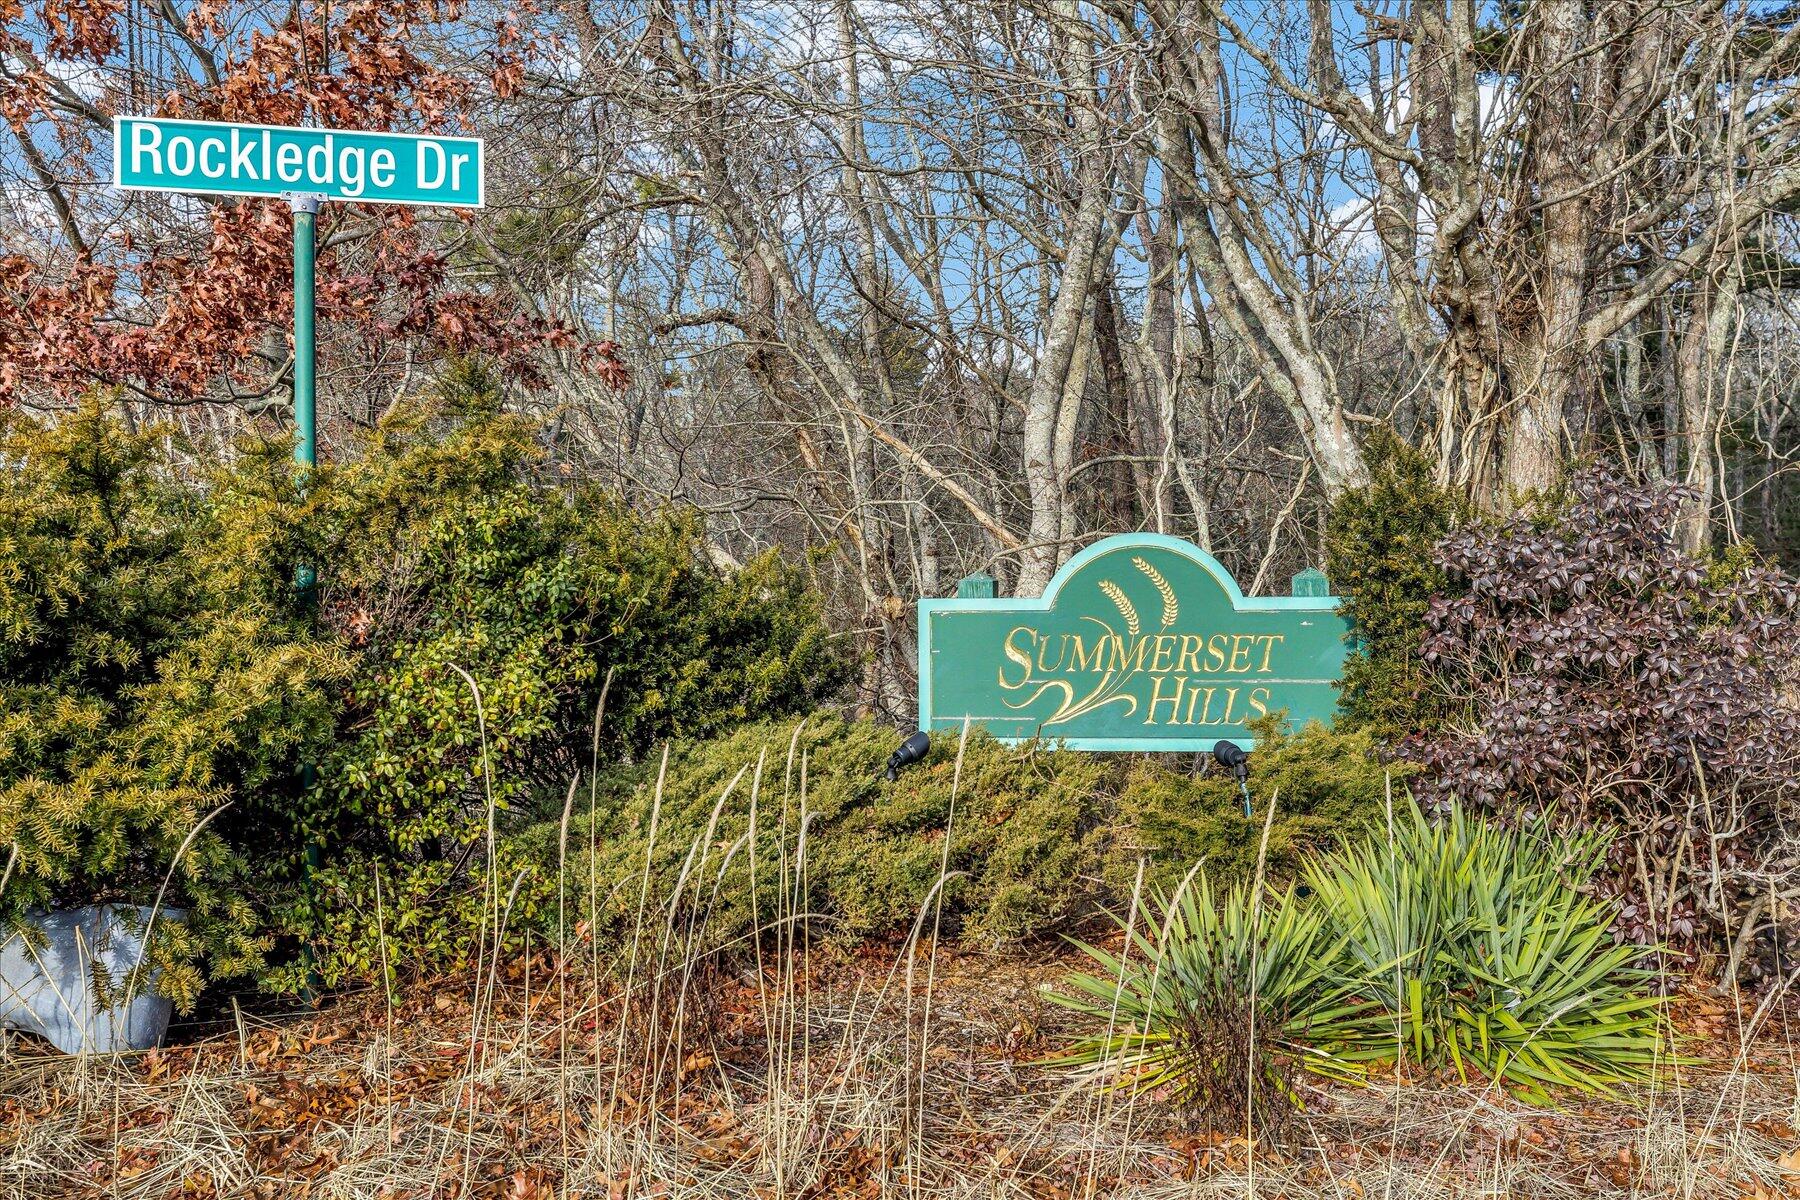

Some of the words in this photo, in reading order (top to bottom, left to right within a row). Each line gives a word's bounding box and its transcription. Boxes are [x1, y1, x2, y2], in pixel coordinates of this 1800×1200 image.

[131, 121, 396, 197] Rockledge
[416, 140, 469, 191] Dr
[999, 627, 1284, 689] SUMMERSET
[1142, 676, 1271, 725] HILLS
